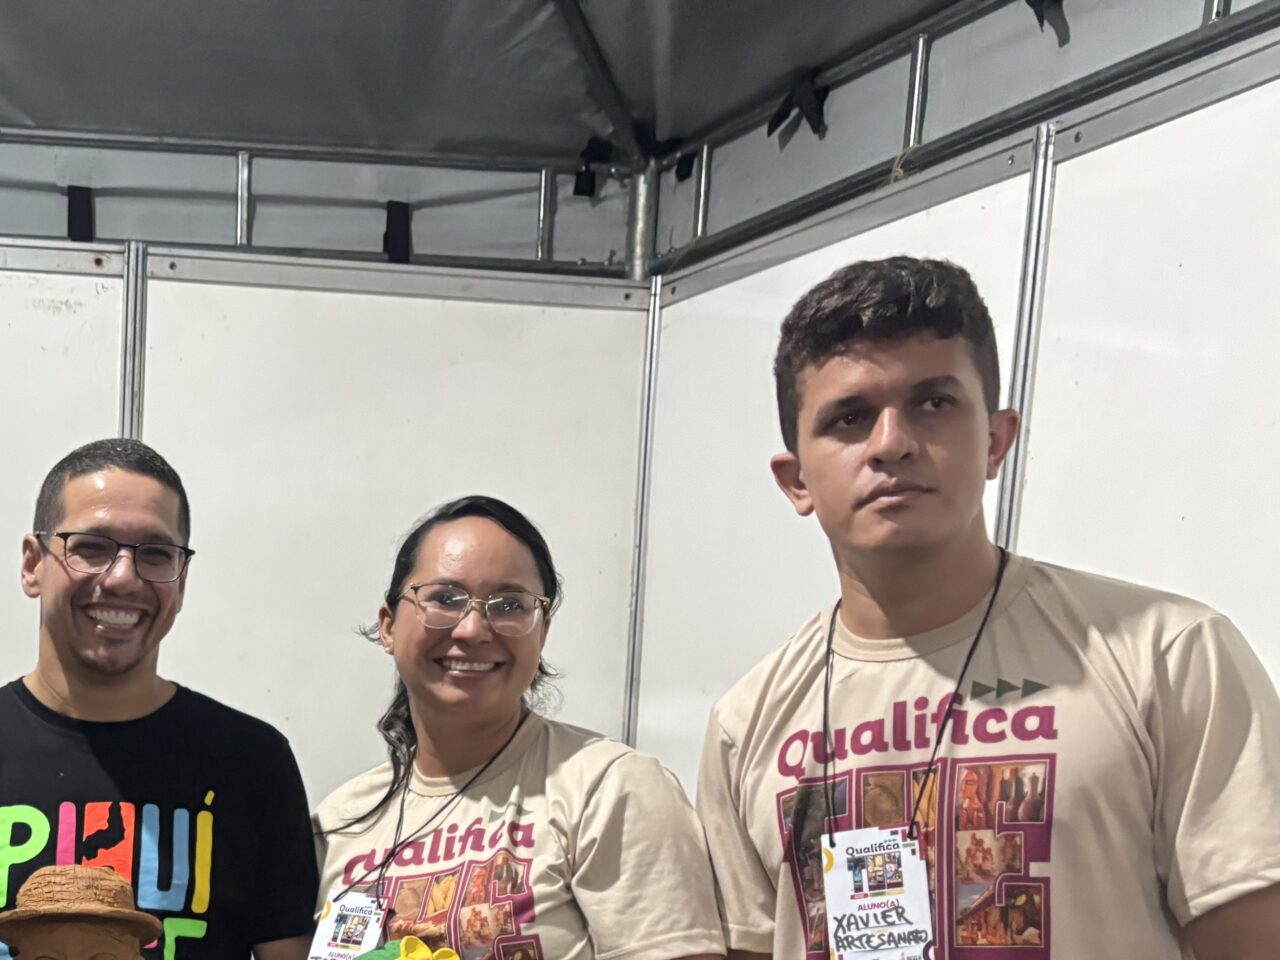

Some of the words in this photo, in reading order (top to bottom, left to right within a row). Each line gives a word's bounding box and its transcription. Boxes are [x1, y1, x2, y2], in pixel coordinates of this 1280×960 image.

[777, 692, 1059, 783] Qualifica
[846, 842, 901, 856] Qualifica
[340, 904, 373, 916] Qualifica
[833, 905, 914, 937] XAVIER
